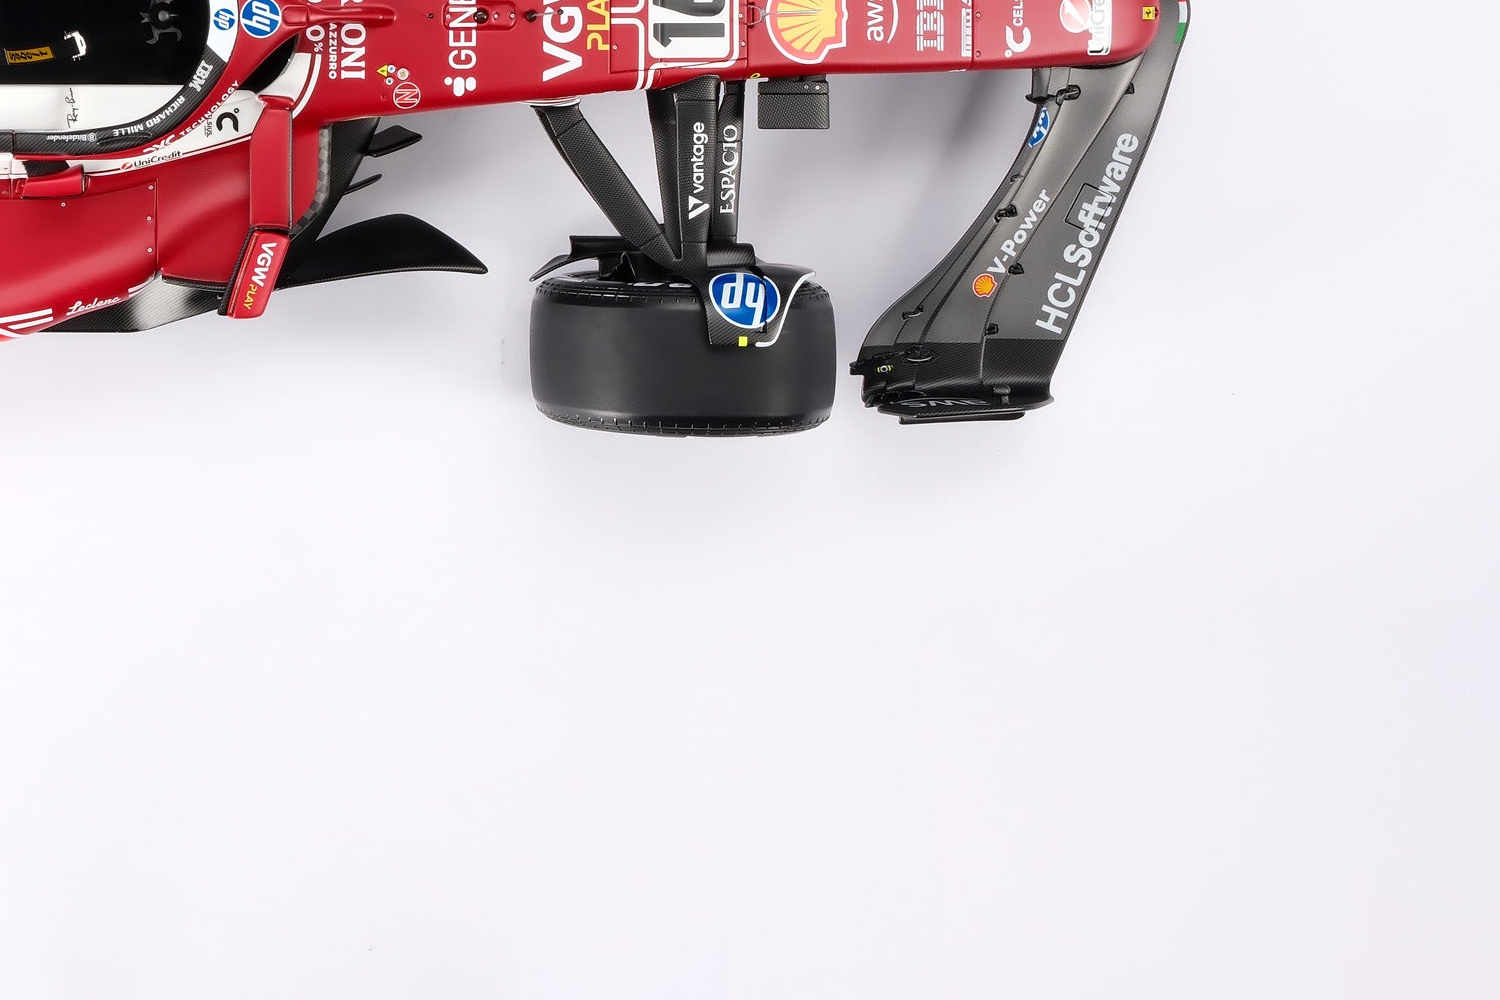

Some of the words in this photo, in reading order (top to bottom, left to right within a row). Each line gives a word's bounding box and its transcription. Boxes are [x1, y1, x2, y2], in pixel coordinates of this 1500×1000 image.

[213, 10, 235, 30] hp
[241, 0, 280, 34] hp
[328, 22, 338, 80] AZZURRO
[189, 60, 214, 92] IBM
[64, 87, 79, 128] Ray-Ban
[146, 95, 185, 128] RICHARD
[179, 80, 239, 137] TECHNOLOGY
[46, 133, 88, 142] Bitdefender
[113, 125, 144, 137] MILLE
[134, 150, 181, 168] UniCredit
[690, 122, 708, 194] vantage
[719, 124, 738, 215] ESPACIO
[987, 188, 1051, 276] V-Power
[1035, 132, 1139, 335] HCLSoftware
[251, 242, 277, 287] VGW
[66, 296, 122, 316] Leclerc
[243, 284, 258, 311] PLAY
[719, 273, 767, 328] hp
